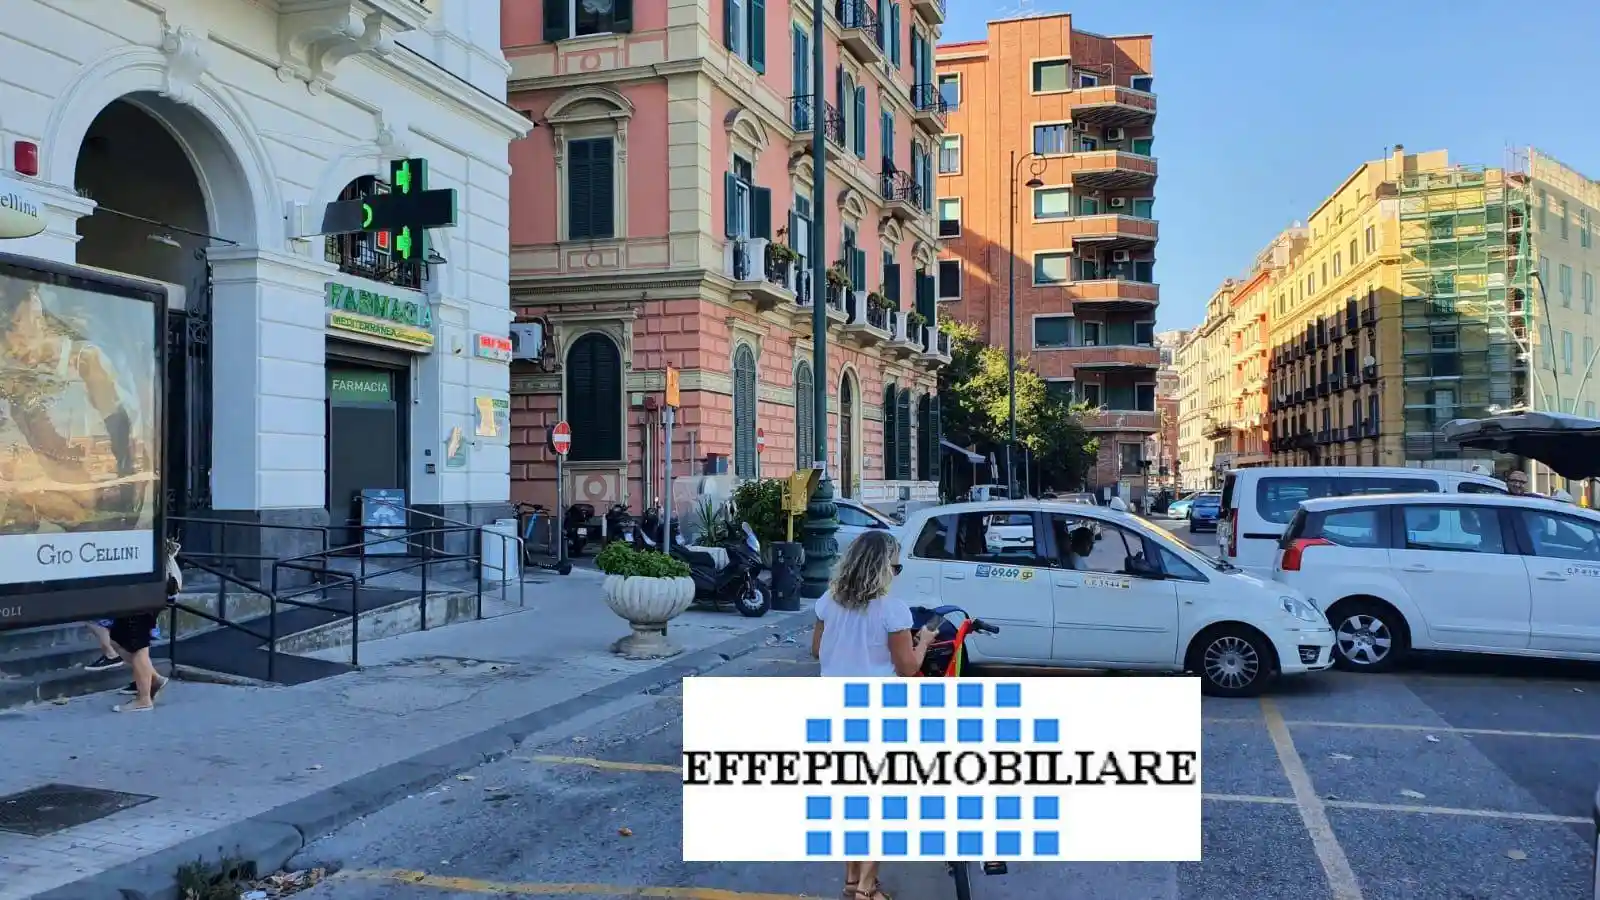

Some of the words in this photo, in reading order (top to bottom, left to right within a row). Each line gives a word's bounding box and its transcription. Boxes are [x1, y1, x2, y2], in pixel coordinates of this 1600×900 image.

[329, 281, 432, 327] FARMACIA
[332, 379, 388, 393] FARMACIA
[79, 542, 140, 563] CELLINI
